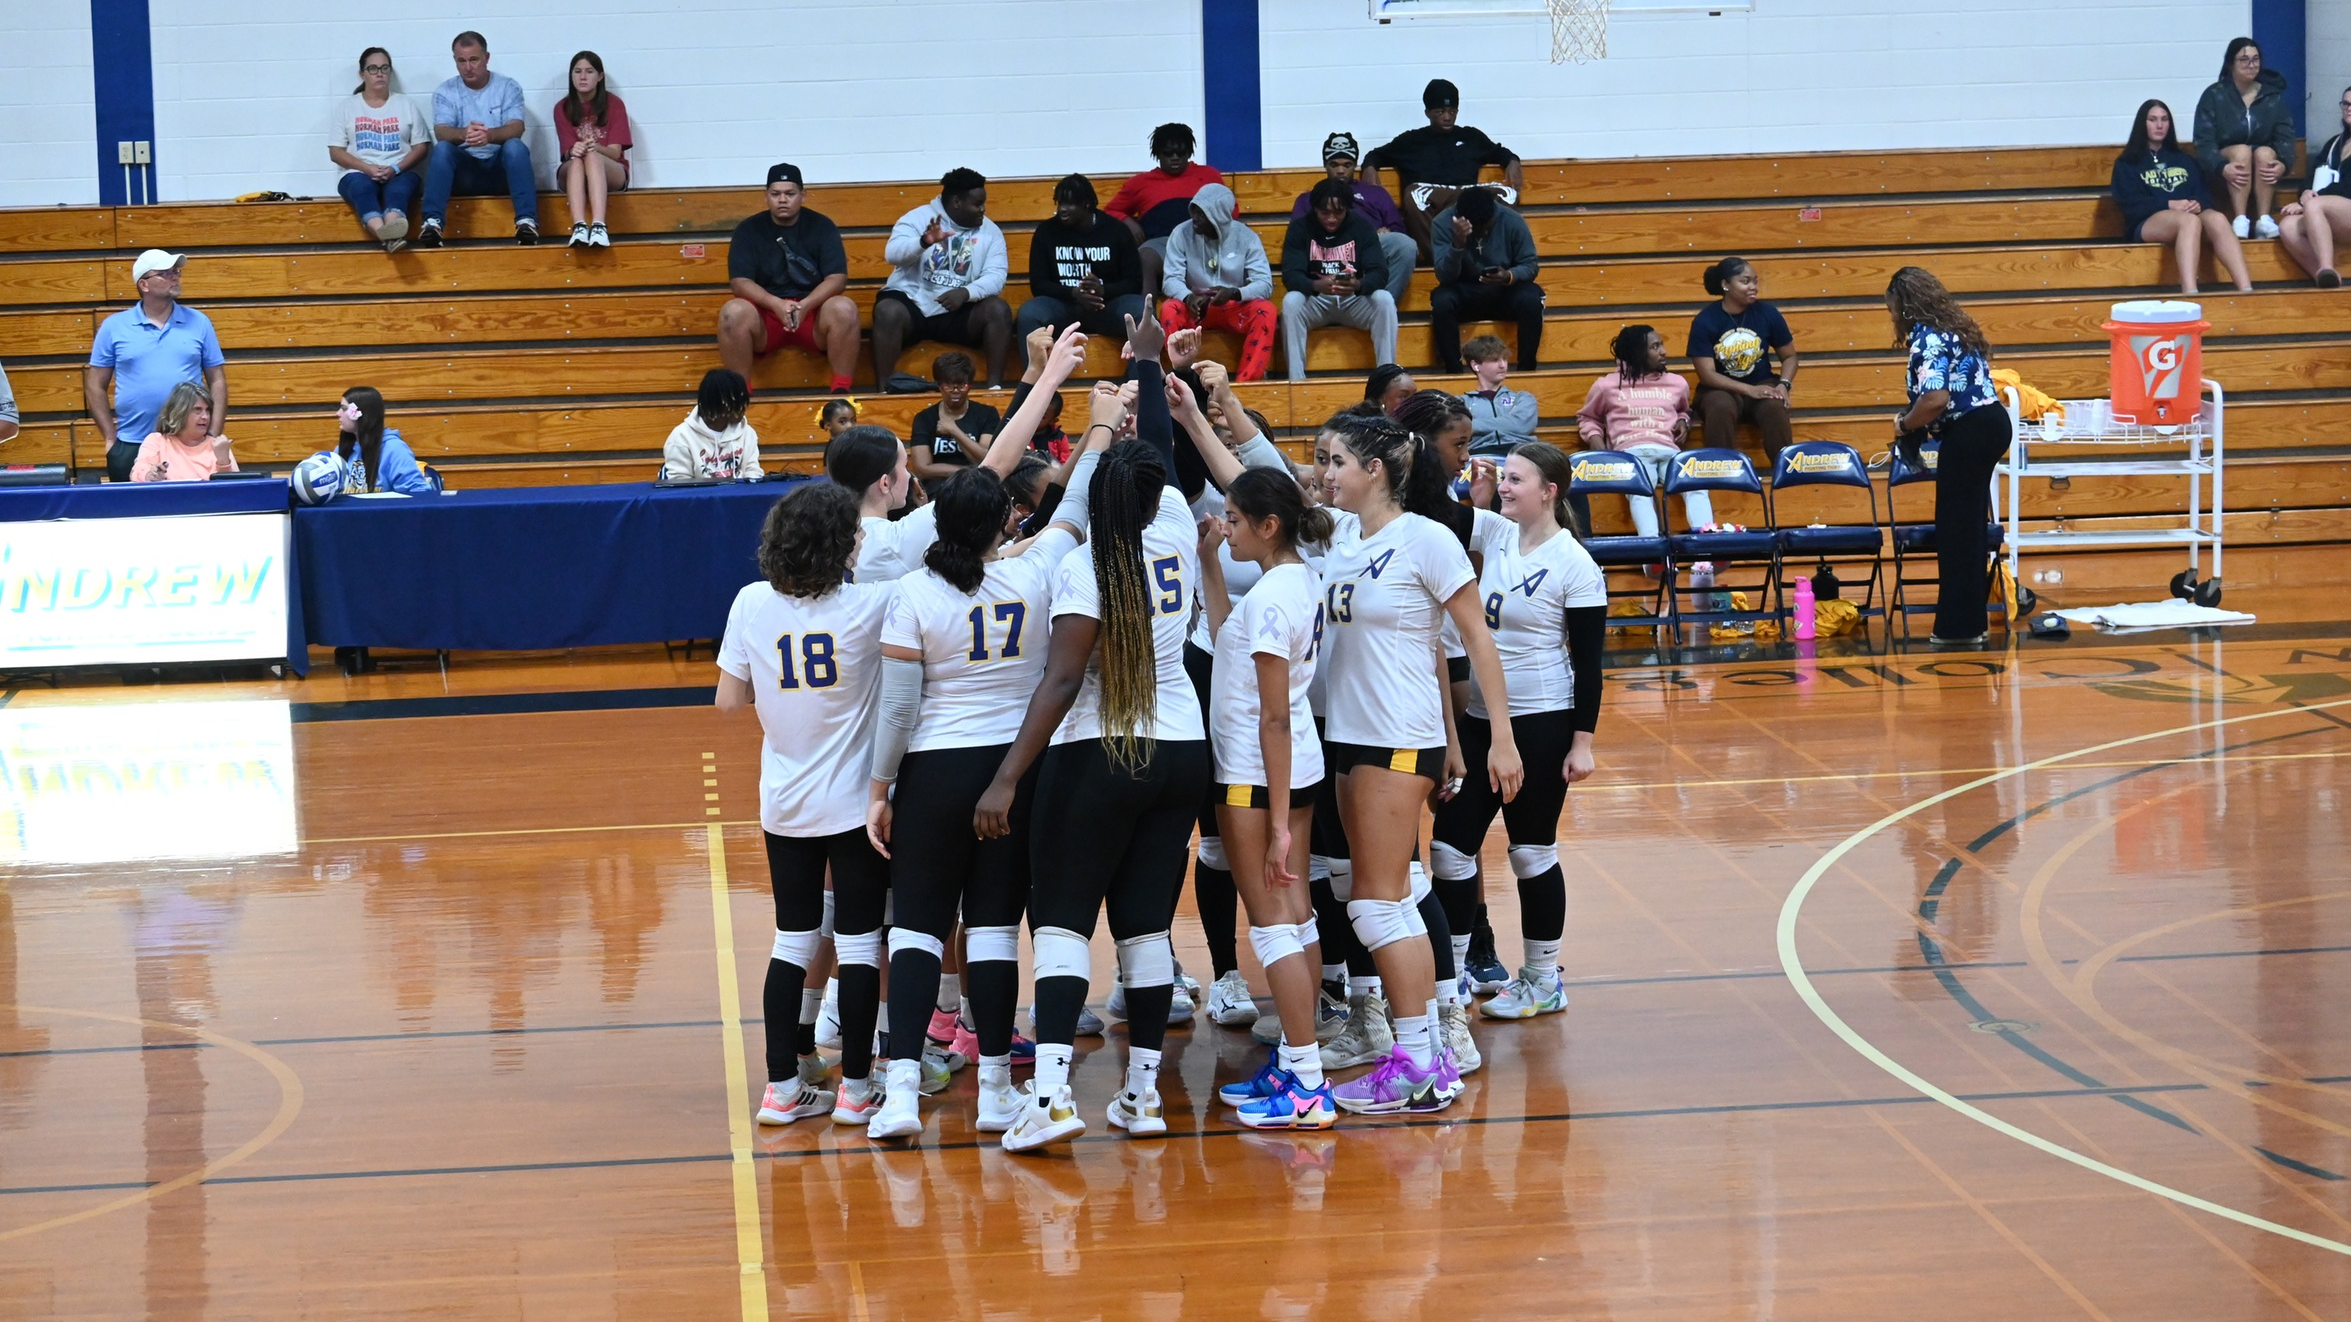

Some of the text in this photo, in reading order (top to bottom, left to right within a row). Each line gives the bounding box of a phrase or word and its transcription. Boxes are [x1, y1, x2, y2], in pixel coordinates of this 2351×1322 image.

[355, 122, 400, 134] NORMAN PARK
[355, 132, 400, 142] NORMAN PARK
[356, 141, 400, 151] NORMAN PARK
[1055, 246, 1111, 261] KNOW YOUR
[1057, 263, 1092, 277] WORTH
[2148, 340, 2176, 371] G
[1617, 387, 1673, 401] A humble
[1627, 404, 1665, 417] human
[1630, 416, 1665, 429] with a
[933, 436, 963, 456] JES
[1571, 459, 1635, 482] ANDREW
[1677, 457, 1744, 479] ANDREW
[1784, 452, 1851, 473] ANDREW
[0, 540, 273, 613] NDREW
[1327, 581, 1356, 625] 13
[1485, 589, 1506, 633] 9
[967, 599, 1029, 664] 17
[775, 630, 838, 692] 18
[1602, 656, 2161, 690] Colleg
